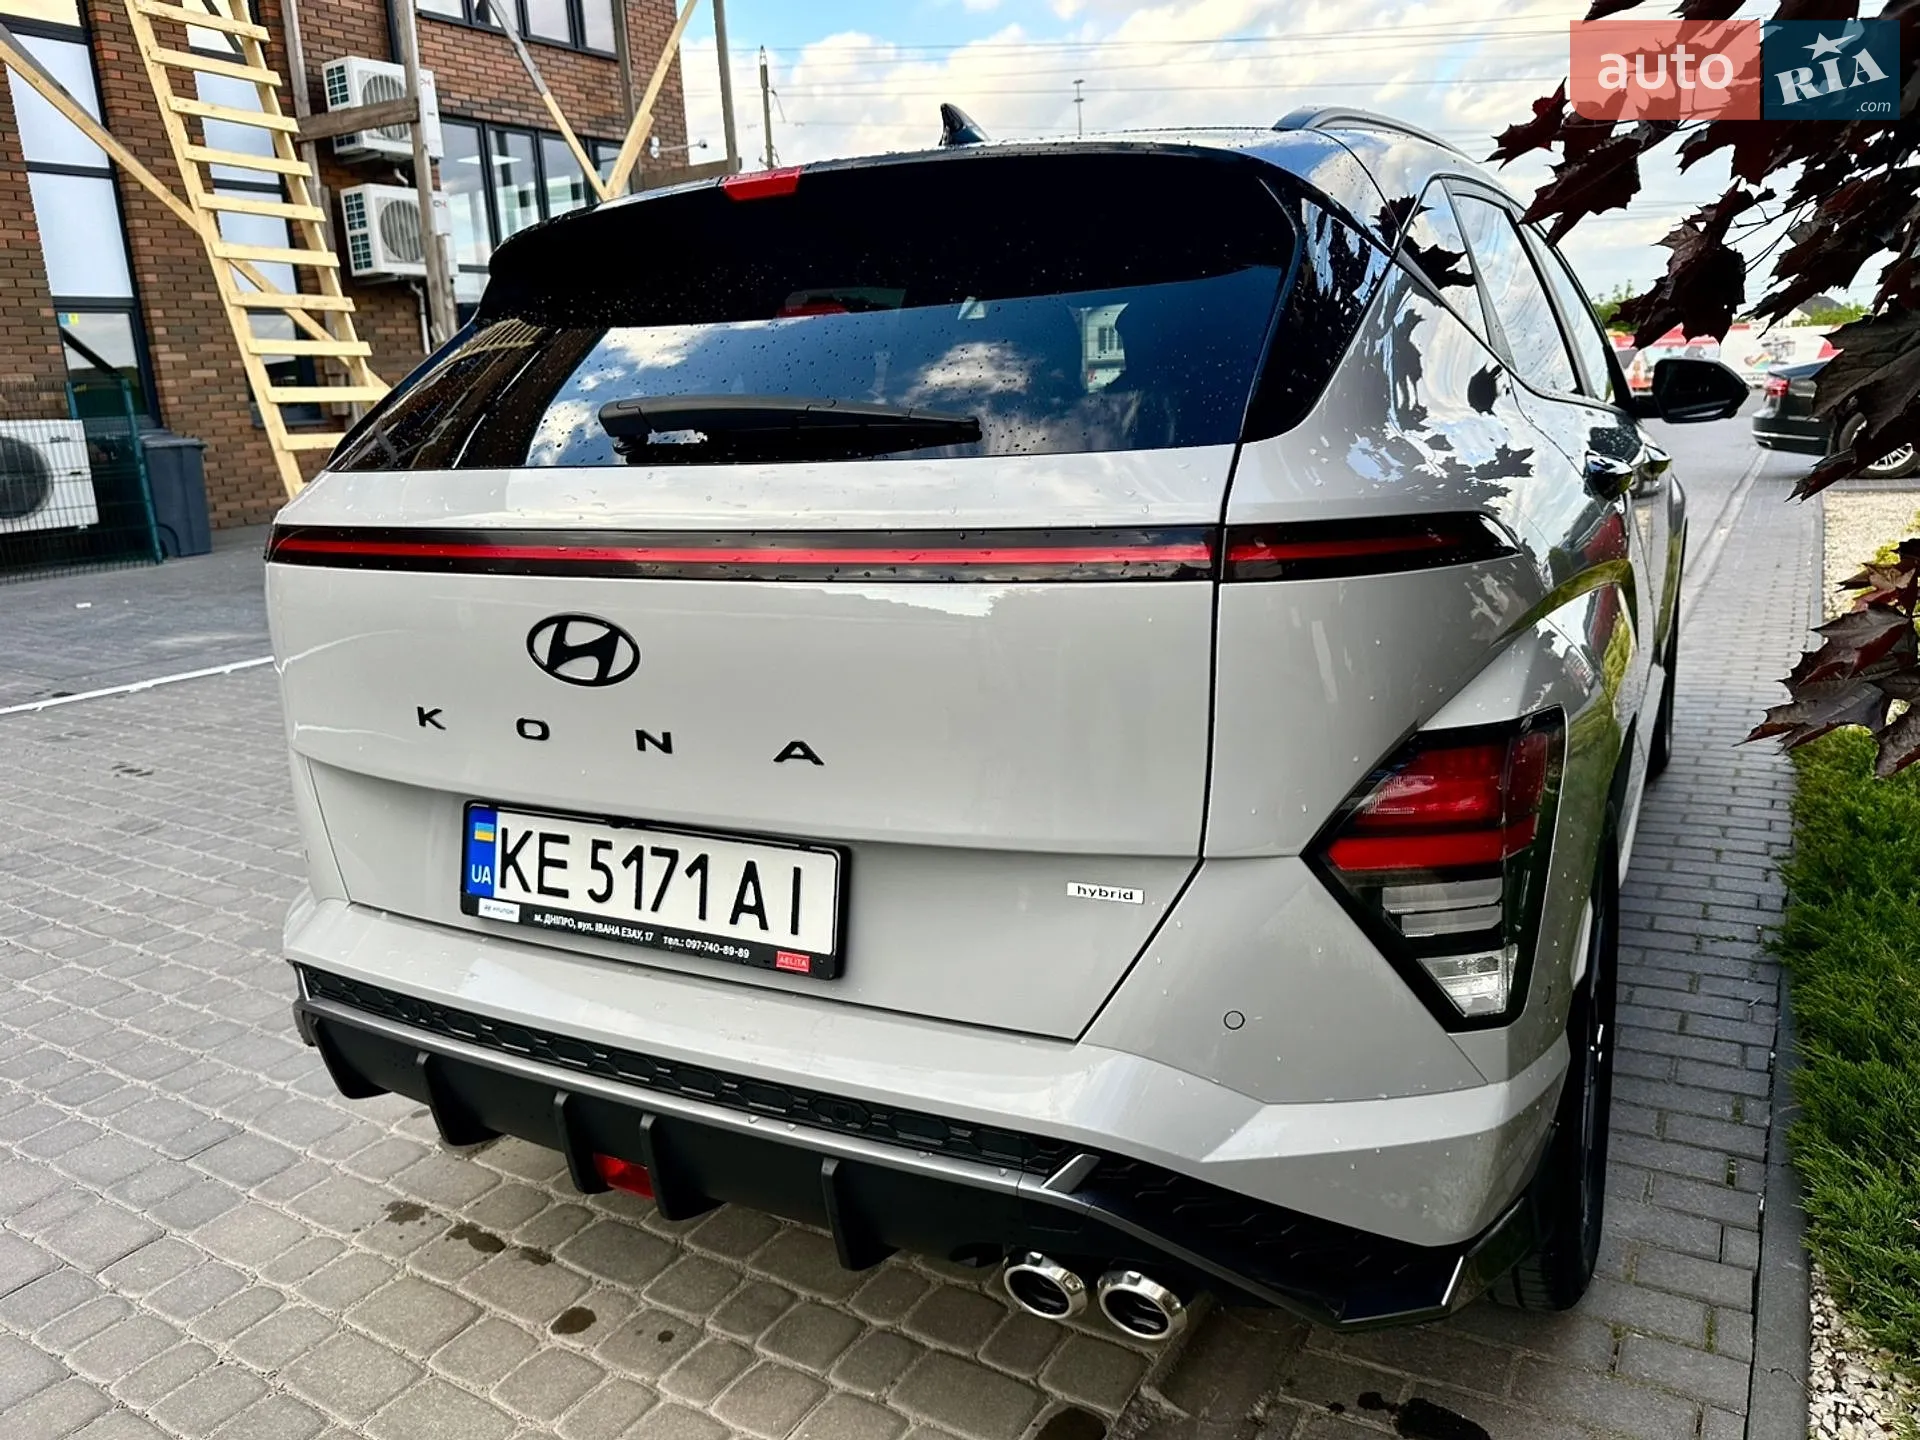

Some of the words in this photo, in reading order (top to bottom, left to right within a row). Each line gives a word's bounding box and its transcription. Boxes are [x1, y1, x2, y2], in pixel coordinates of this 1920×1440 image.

[417, 706, 825, 766] KONA
[471, 864, 492, 886] UA
[500, 827, 571, 899] KE
[587, 838, 709, 921] 5171
[729, 859, 802, 936] AI
[1077, 885, 1134, 900] hybrid
[685, 938, 750, 959] 097-740-89-89
